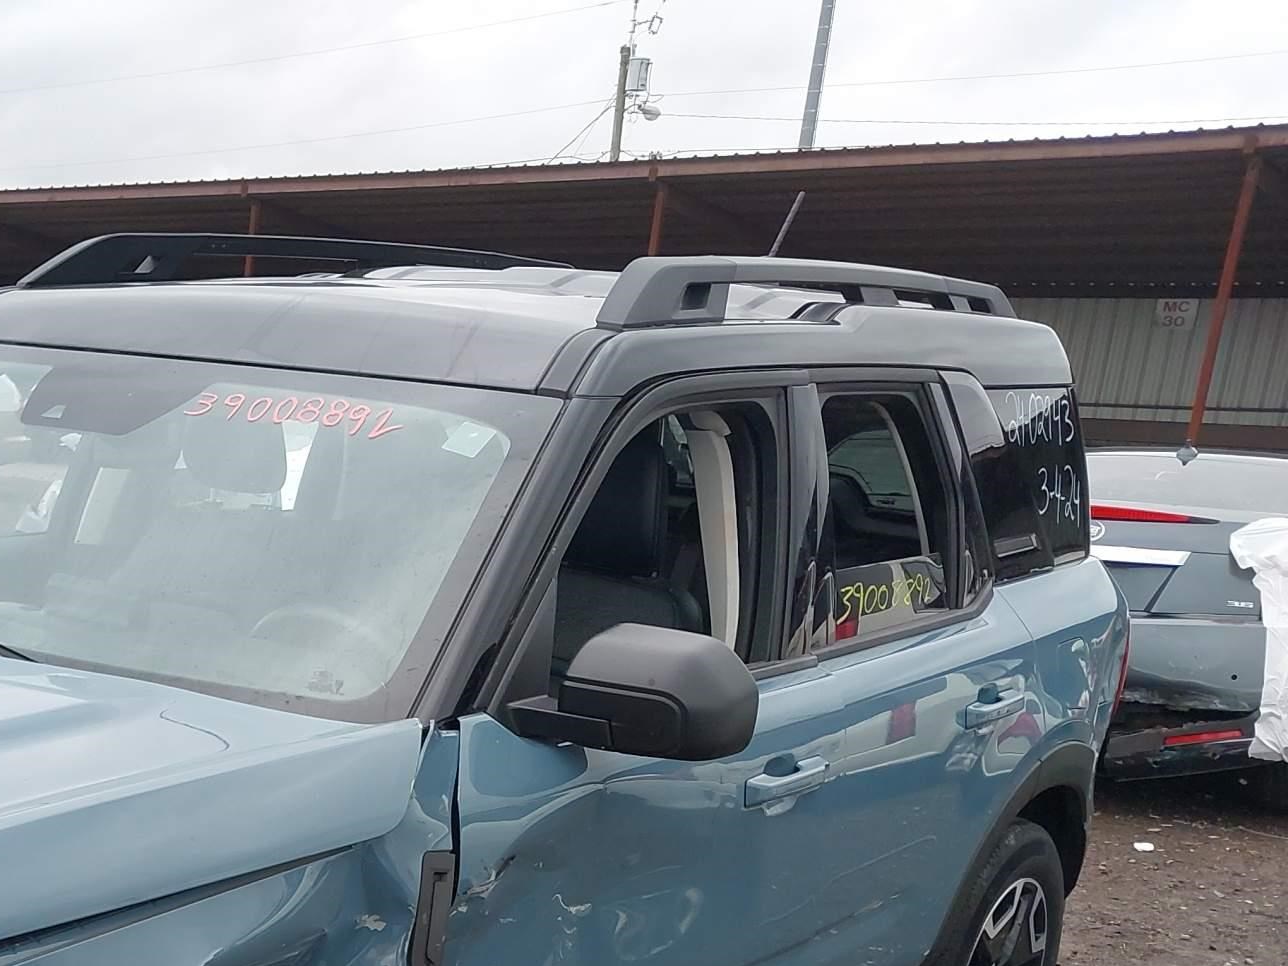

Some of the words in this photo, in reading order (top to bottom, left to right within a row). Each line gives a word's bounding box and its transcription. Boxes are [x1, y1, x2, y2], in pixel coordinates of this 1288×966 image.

[1162, 315, 1185, 328] 30
[1163, 300, 1191, 313] MC
[183, 391, 404, 440] 39008892
[1037, 464, 1081, 529] 3-4-24
[836, 573, 934, 626] 39008892
